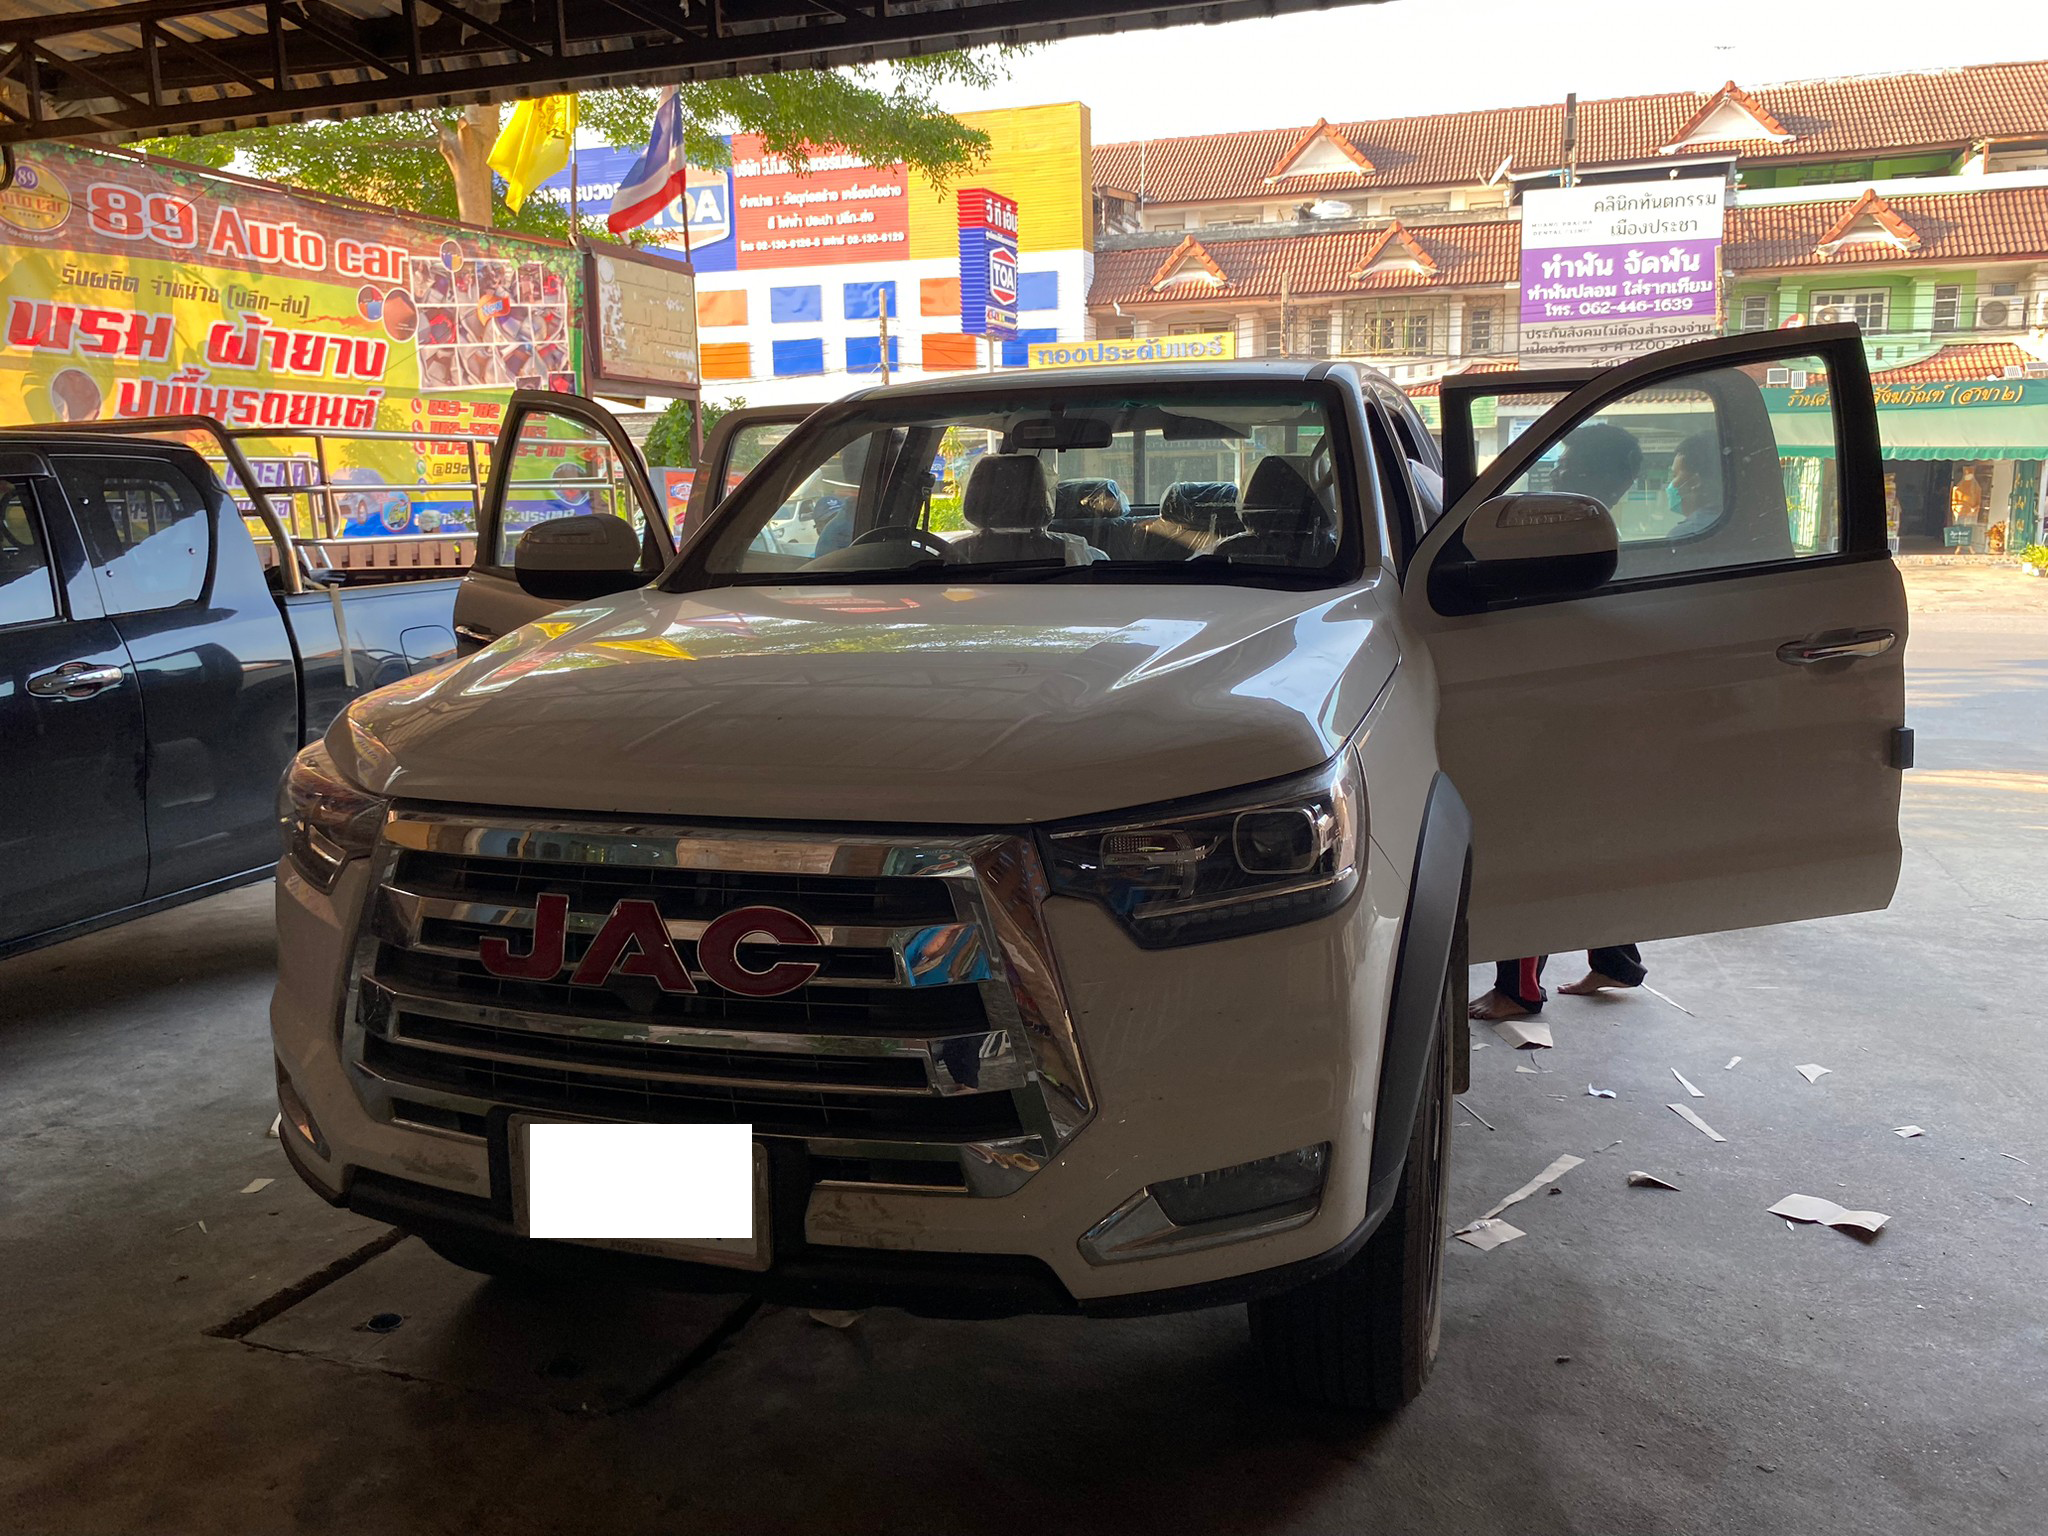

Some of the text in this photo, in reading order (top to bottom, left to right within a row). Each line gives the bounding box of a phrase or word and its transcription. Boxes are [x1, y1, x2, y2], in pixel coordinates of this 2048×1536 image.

[17, 168, 37, 186] 89
[985, 198, 993, 223] วี
[994, 202, 1001, 227] ที
[1594, 192, 1716, 213] คลินิกทันตกรรม
[86, 182, 409, 284] 89 Auto car
[1610, 218, 1699, 236] เมืองประชา
[993, 263, 1014, 290] TOA
[1542, 247, 1700, 279] ทำฟัน จัดฟัน
[61, 263, 139, 294] รับผลิต
[151, 274, 219, 304] จำหน่าย
[1527, 276, 1713, 301] ทำฟันปลอม ใส่รากเทียม
[1579, 298, 1694, 316] 062-446-1639
[4, 298, 389, 381] พรม ผ้ายาง
[1526, 322, 1712, 339] ประกันสังคมไม่ต้องสำรองจ่าย
[1037, 335, 1224, 365] ทองประดับแอร์
[479, 892, 823, 997] JAC
